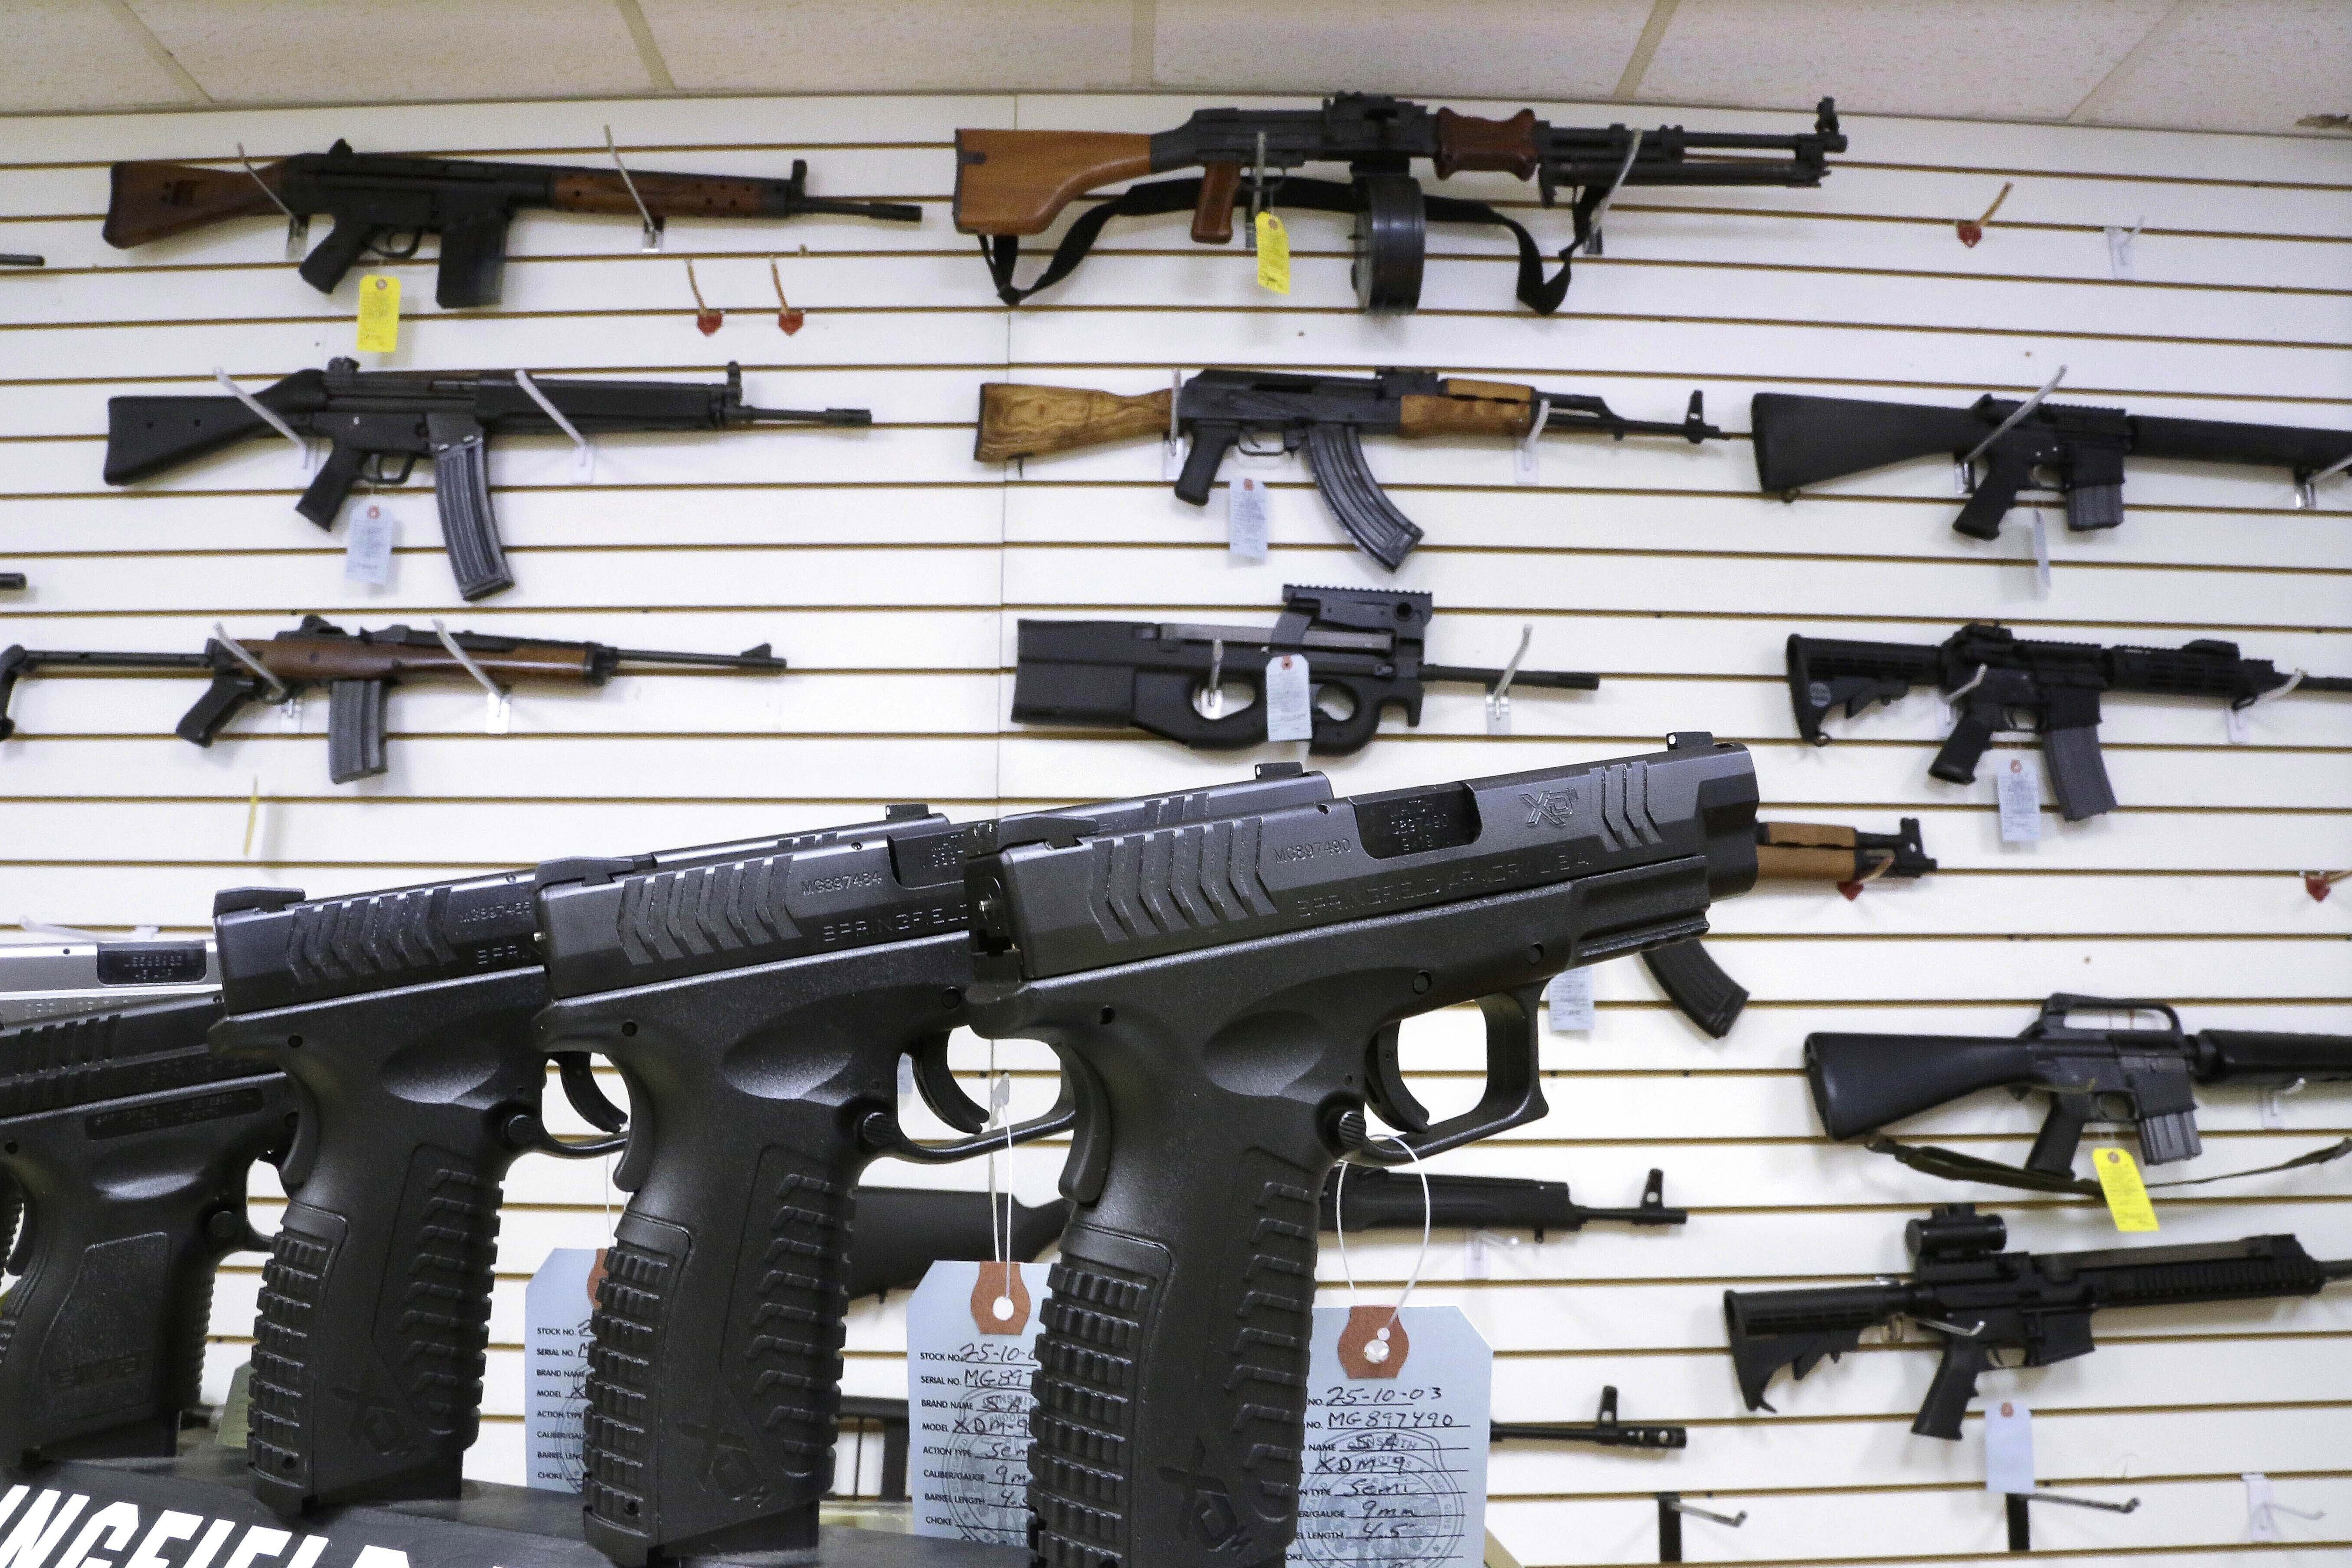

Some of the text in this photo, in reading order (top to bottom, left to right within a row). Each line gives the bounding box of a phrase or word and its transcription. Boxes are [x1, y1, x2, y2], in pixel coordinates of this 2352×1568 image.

[920, 1351, 945, 1361] STOCK
[921, 1375, 945, 1384] SERIAL
[1325, 1386, 1442, 1407] 25-10-03
[921, 1399, 948, 1408] BRAND
[950, 1400, 974, 1410] NAME
[1328, 1410, 1453, 1428] MG897490
[922, 1423, 949, 1432] MODEL
[923, 1446, 952, 1456] ACTION
[924, 1492, 952, 1503] BARREL
[926, 1516, 952, 1526] CHOKE
